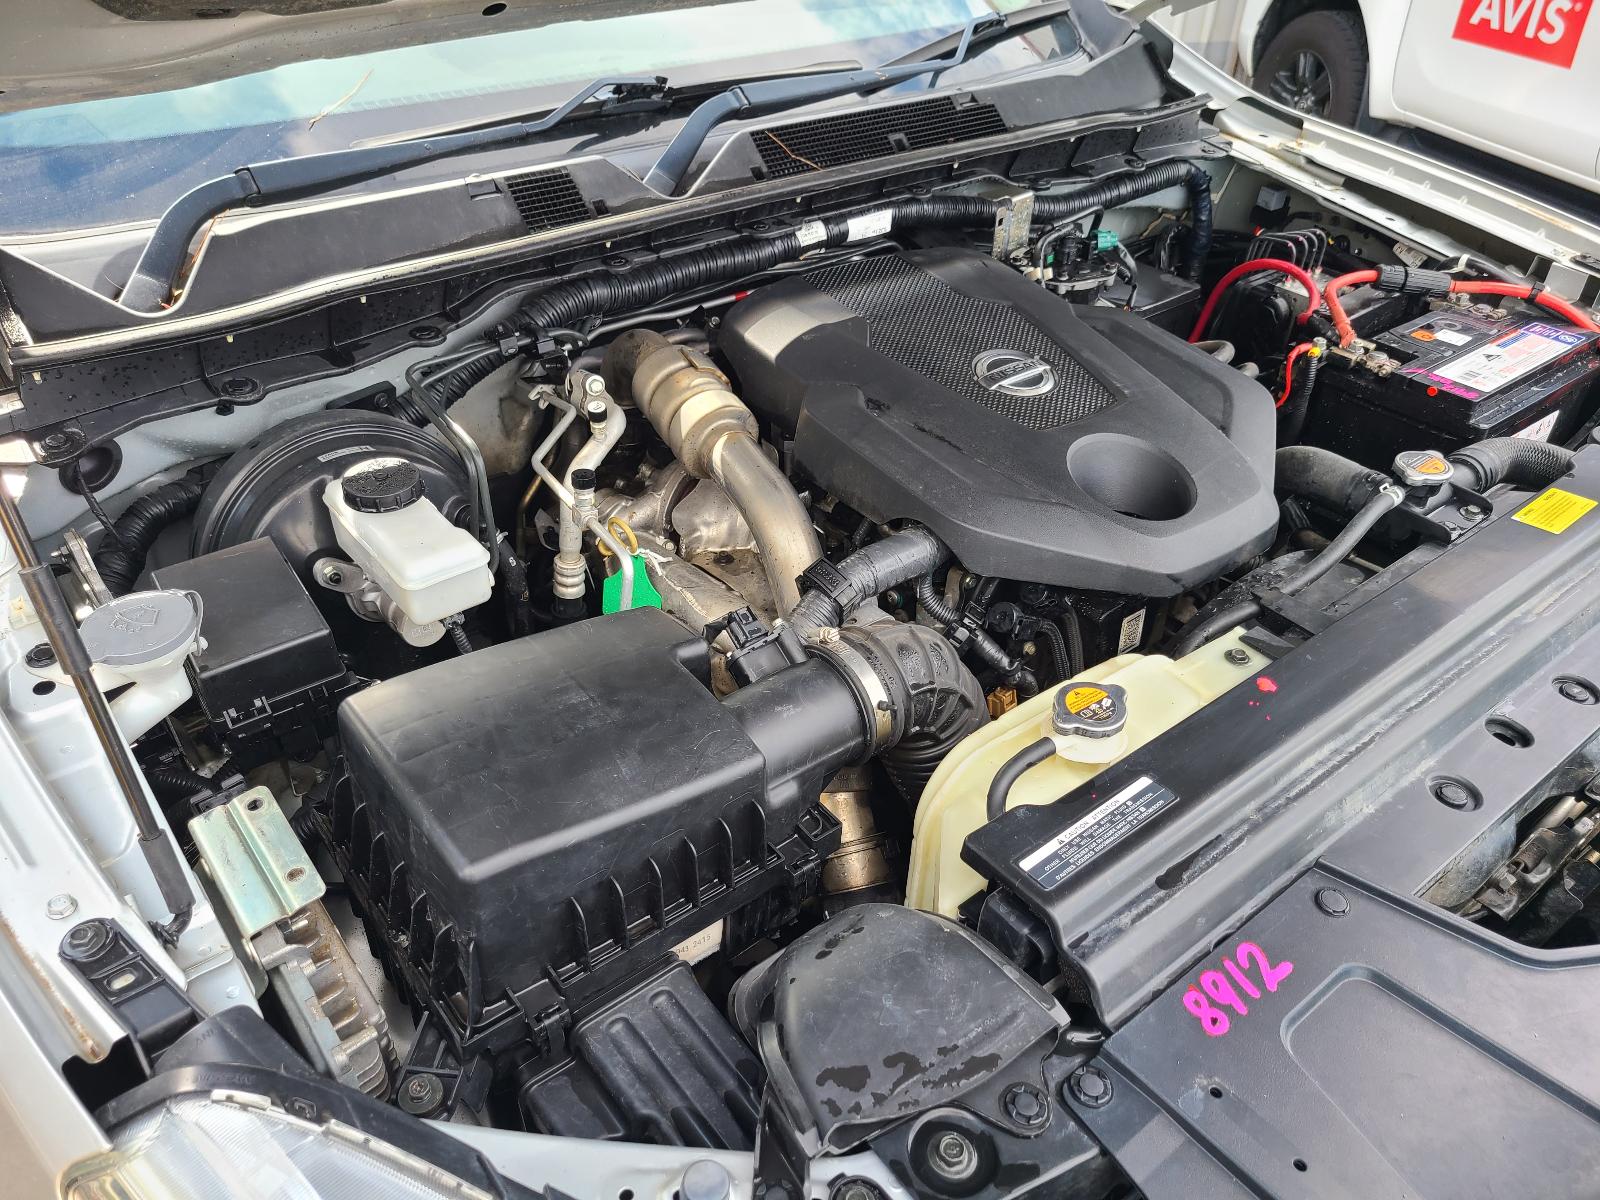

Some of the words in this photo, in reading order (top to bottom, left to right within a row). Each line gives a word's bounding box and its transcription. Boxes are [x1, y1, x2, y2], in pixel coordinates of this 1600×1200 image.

[1469, 0, 1574, 45] AVIS
[987, 360, 1041, 382] NISSAN
[1063, 820, 1090, 839] CAUTION
[1090, 799, 1121, 820] ATTENTION
[1043, 858, 1060, 871] OTHER
[1079, 836, 1091, 845] WILL
[1091, 821, 1111, 836] DAMAGE
[1111, 813, 1122, 822] THE
[1182, 941, 1295, 1037] 8912
